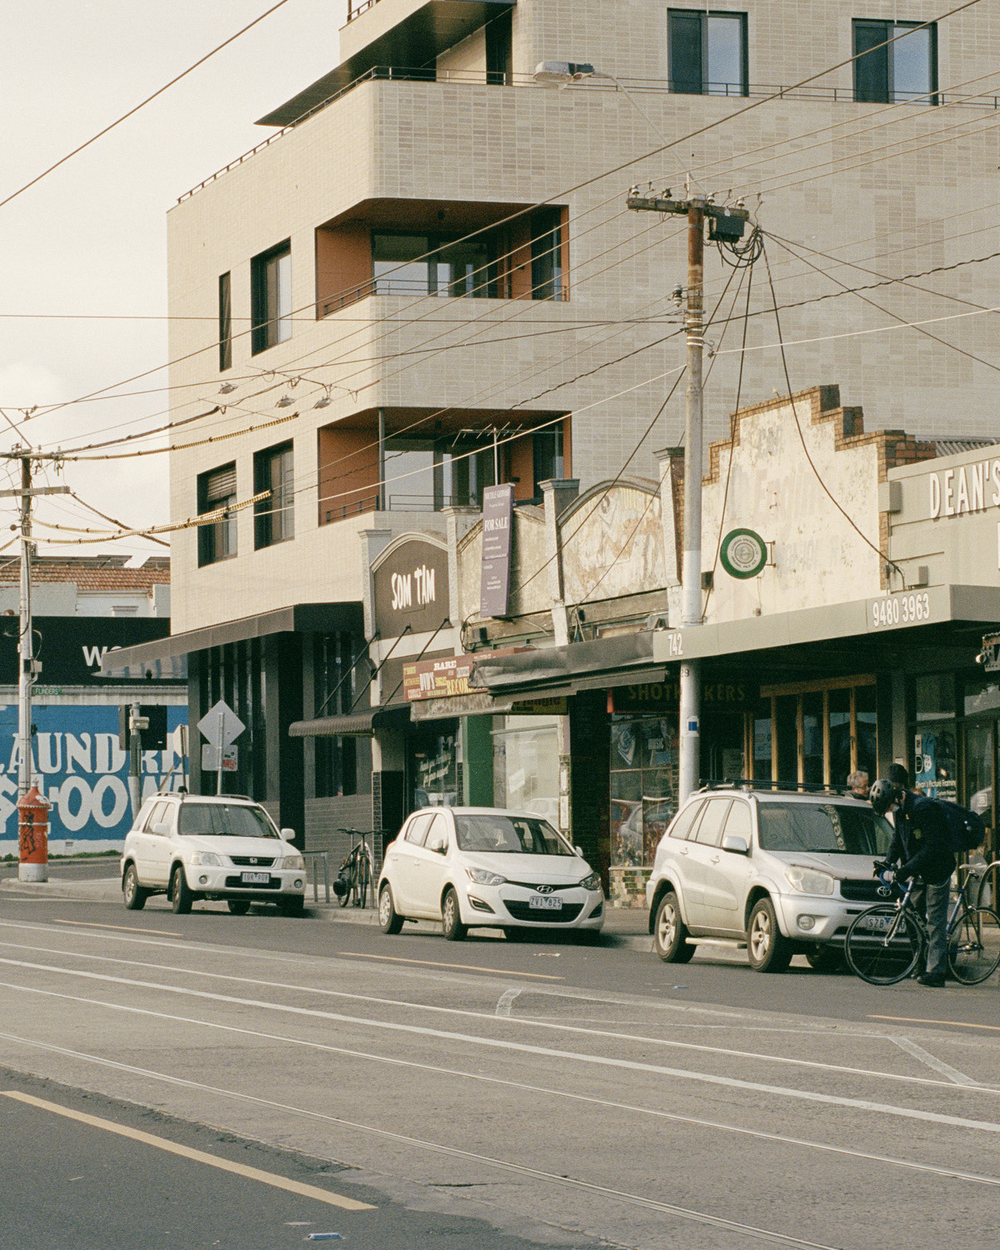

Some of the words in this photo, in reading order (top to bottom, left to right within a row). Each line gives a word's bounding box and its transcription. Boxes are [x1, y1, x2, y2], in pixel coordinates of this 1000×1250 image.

[484, 518, 495, 531] FOR
[495, 516, 508, 530] SALE
[872, 597, 899, 628] 9480
[902, 592, 930, 623] 3963
[667, 633, 684, 657] 742
[434, 660, 457, 671] RARE
